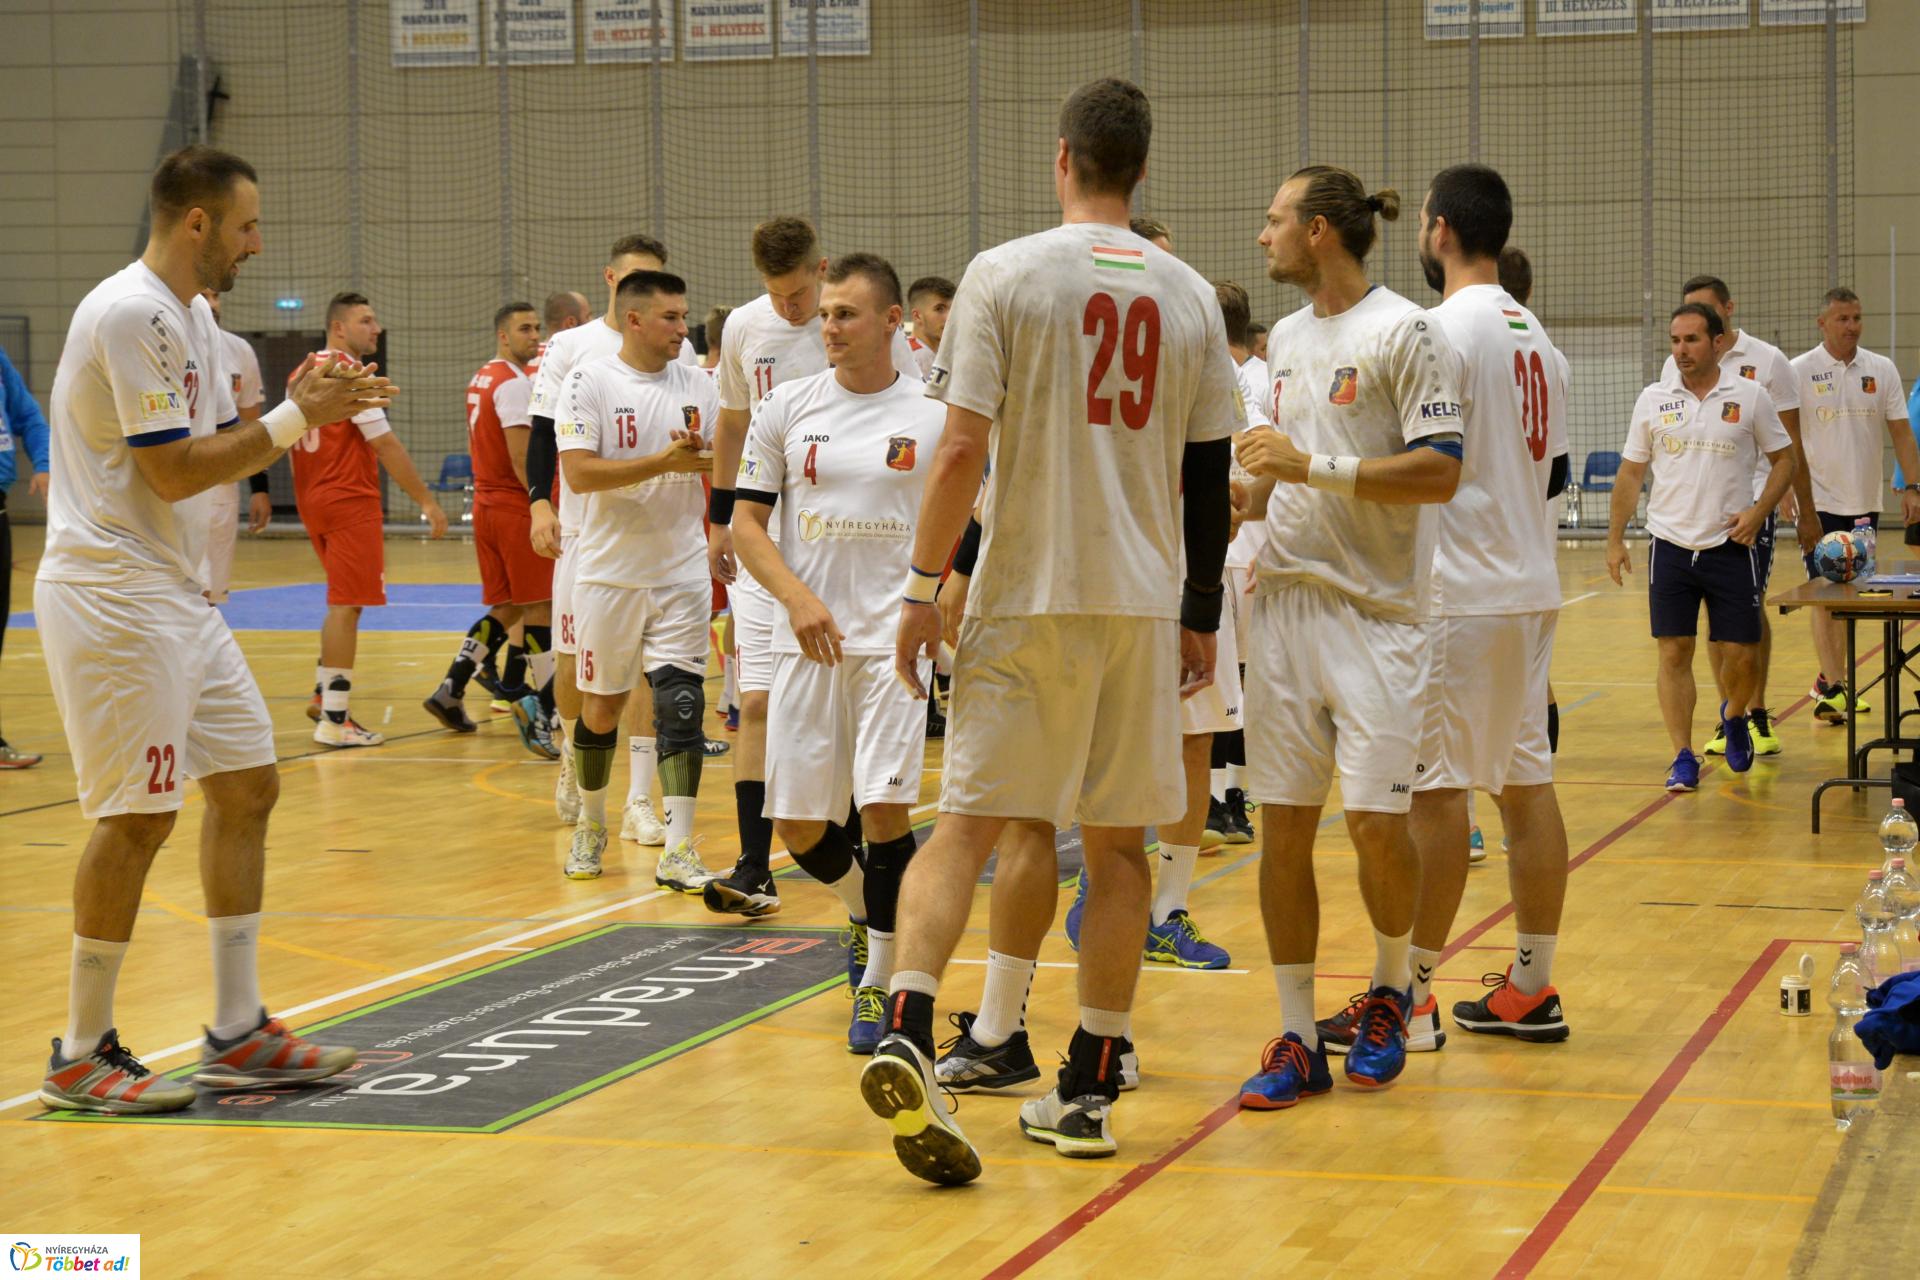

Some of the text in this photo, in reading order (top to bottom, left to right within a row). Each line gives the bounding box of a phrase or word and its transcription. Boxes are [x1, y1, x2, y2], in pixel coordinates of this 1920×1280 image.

[755, 357, 776, 365] JAKO
[1083, 292, 1160, 430] 29
[1811, 371, 1833, 382] KELET
[1421, 402, 1462, 419] KELET
[1660, 400, 1685, 413] KELET
[616, 415, 638, 449] 15
[802, 434, 830, 443] JAKO
[804, 444, 818, 486] 4
[826, 520, 911, 532] NYÍREGYHÁZA
[147, 743, 175, 794] 22
